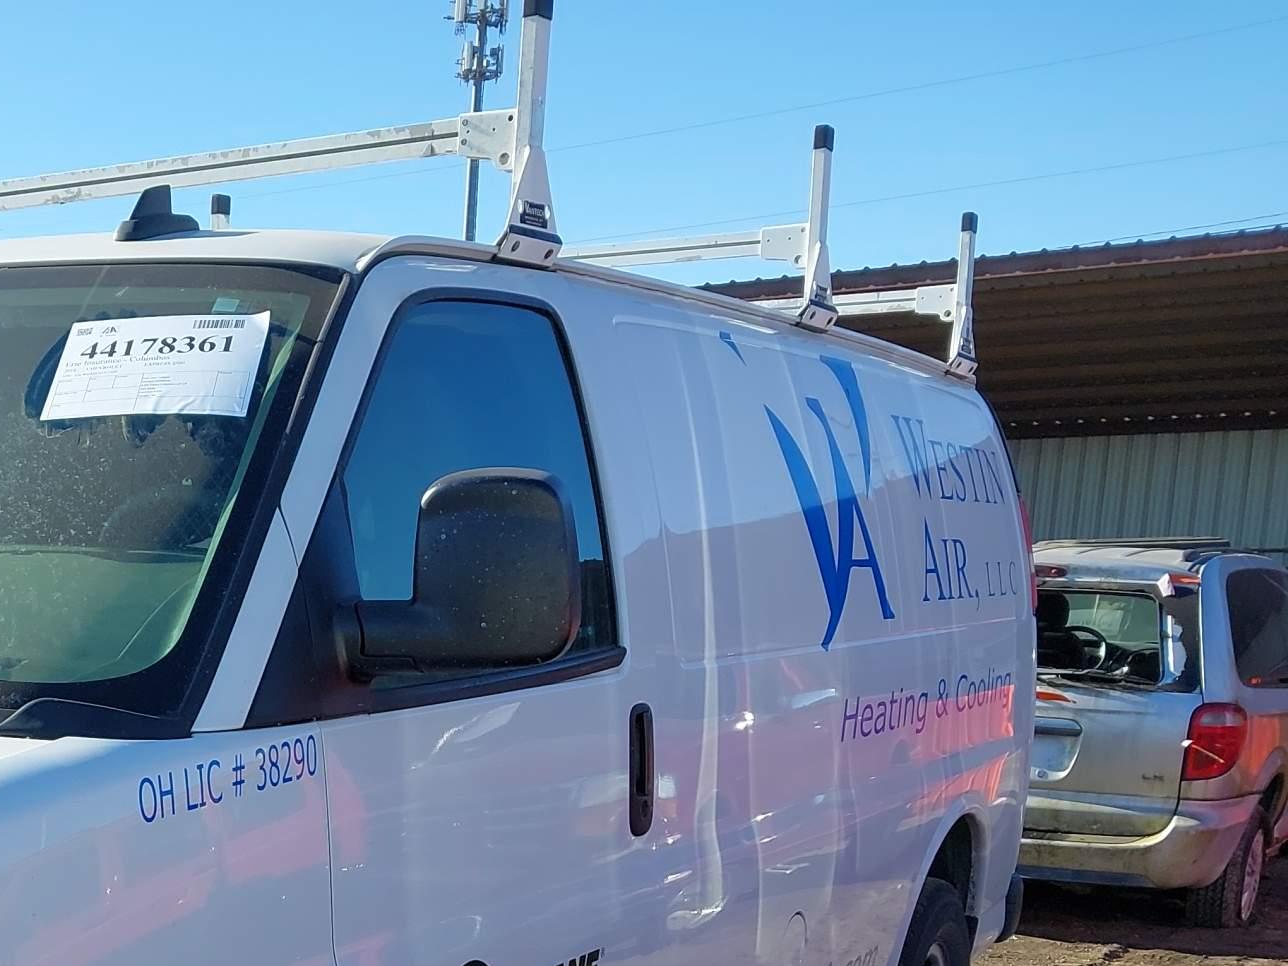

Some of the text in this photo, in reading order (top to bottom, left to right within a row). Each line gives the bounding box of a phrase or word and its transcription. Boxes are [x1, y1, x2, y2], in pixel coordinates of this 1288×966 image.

[80, 335, 233, 359] 44178361
[841, 669, 1013, 742] Heating & Cooling
[138, 734, 317, 823] OH LIC # 38290
